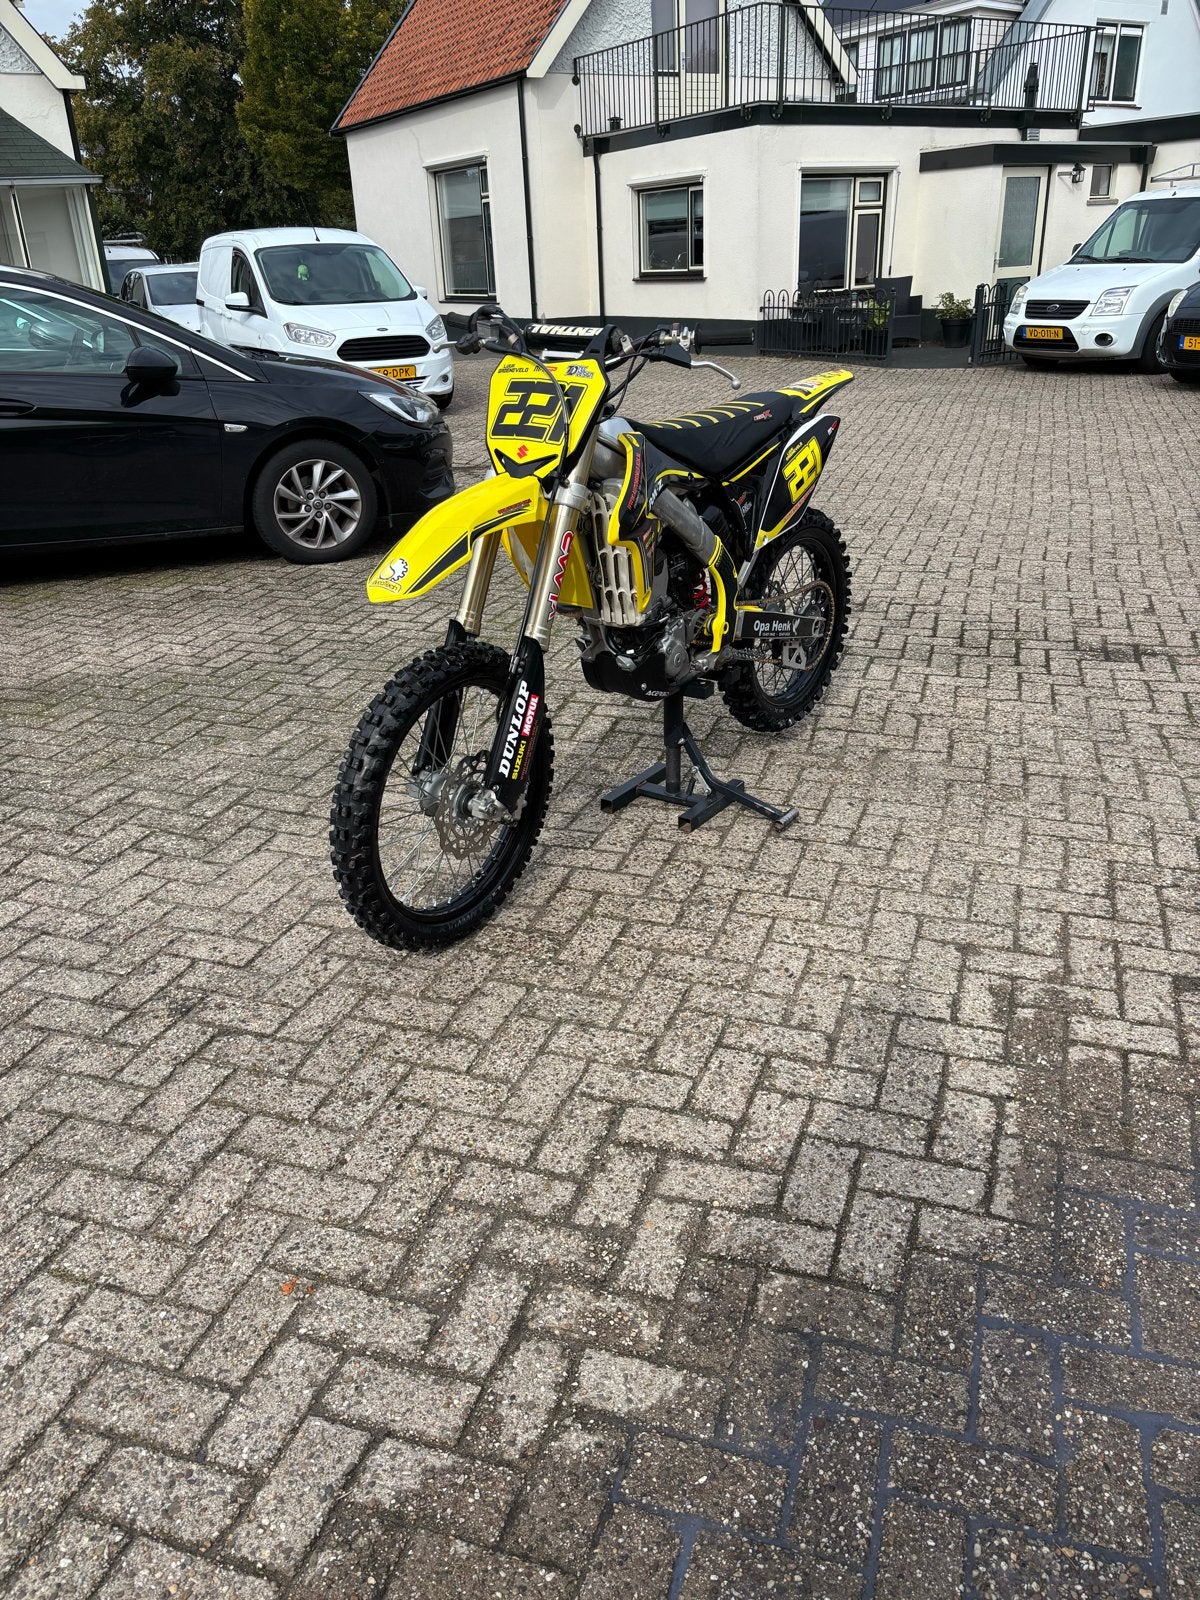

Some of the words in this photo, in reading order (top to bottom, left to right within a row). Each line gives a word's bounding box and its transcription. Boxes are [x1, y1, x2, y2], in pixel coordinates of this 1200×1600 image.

[1029, 329, 1059, 338] VD-011-N
[377, 368, 410, 378] 9-DPK
[491, 380, 587, 443] 221
[754, 619, 770, 636] Opa
[772, 620, 791, 631] Henk
[499, 680, 530, 778] DUNLOP
[523, 696, 539, 736] MOTUL
[512, 740, 527, 780] SUZUKI
